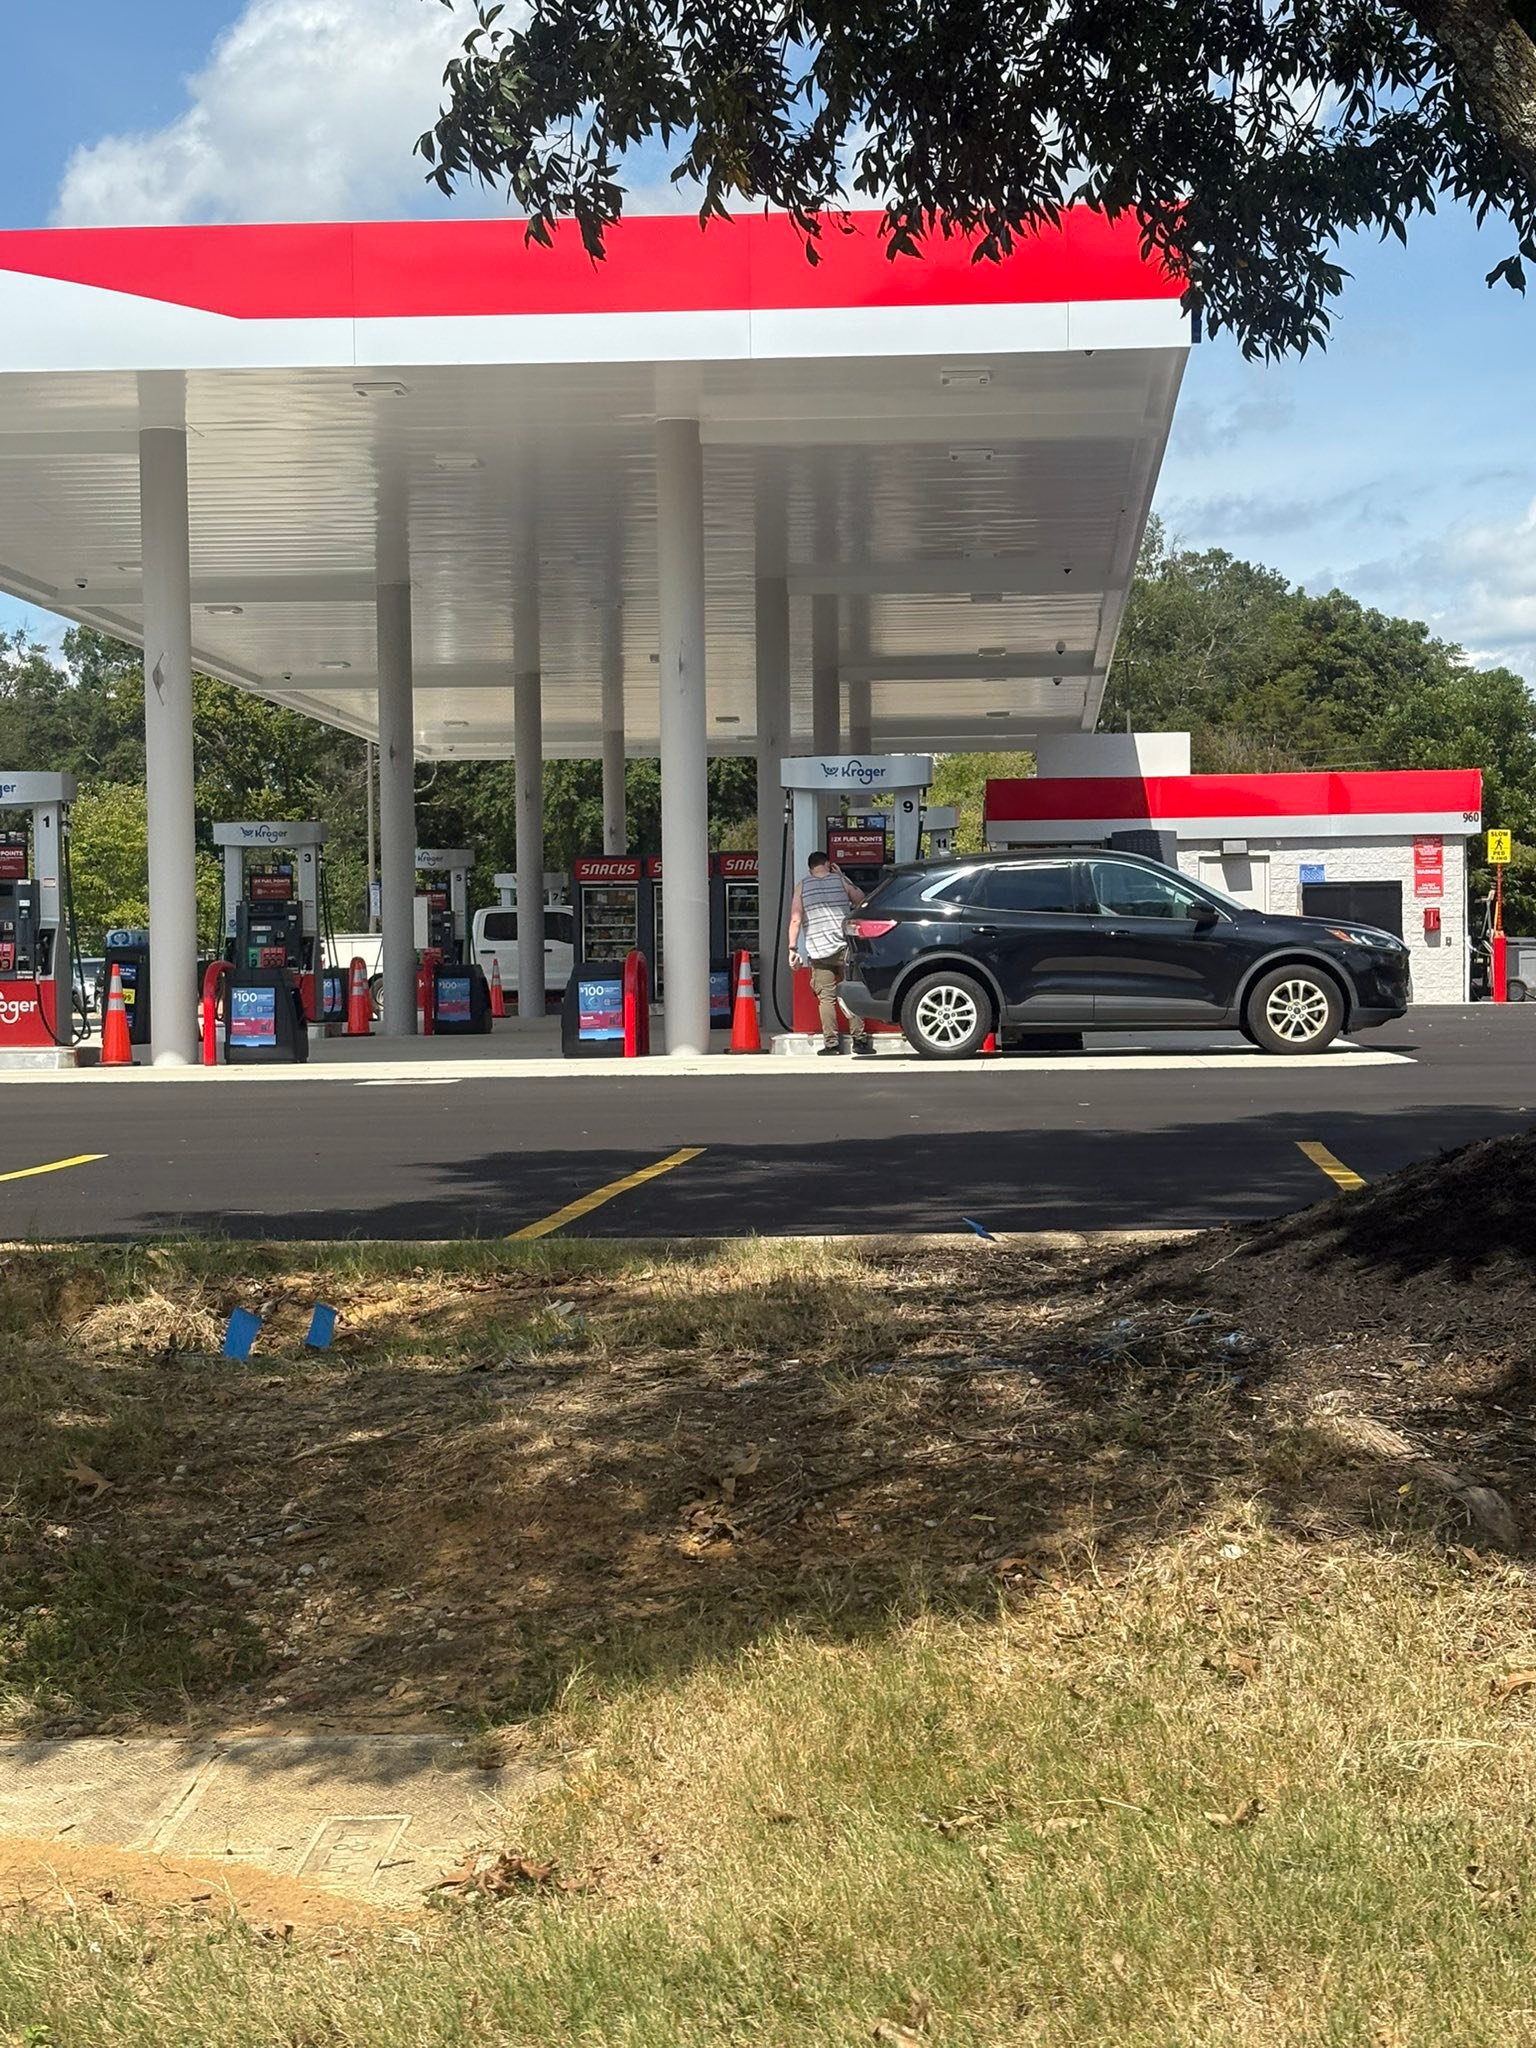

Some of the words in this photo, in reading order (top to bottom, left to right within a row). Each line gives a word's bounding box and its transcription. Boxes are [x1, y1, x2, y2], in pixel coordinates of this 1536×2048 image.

[841, 760, 886, 785] Kroger
[902, 800, 914, 813] 9
[42, 815, 50, 828] 1
[1462, 811, 1480, 823] 960
[255, 825, 288, 843] Kroger
[936, 838, 948, 848] 11
[303, 853, 312, 863] 3
[580, 863, 636, 876] SNACKS
[455, 874, 463, 882] 5
[553, 892, 560, 901] 7
[233, 992, 258, 1003] $100
